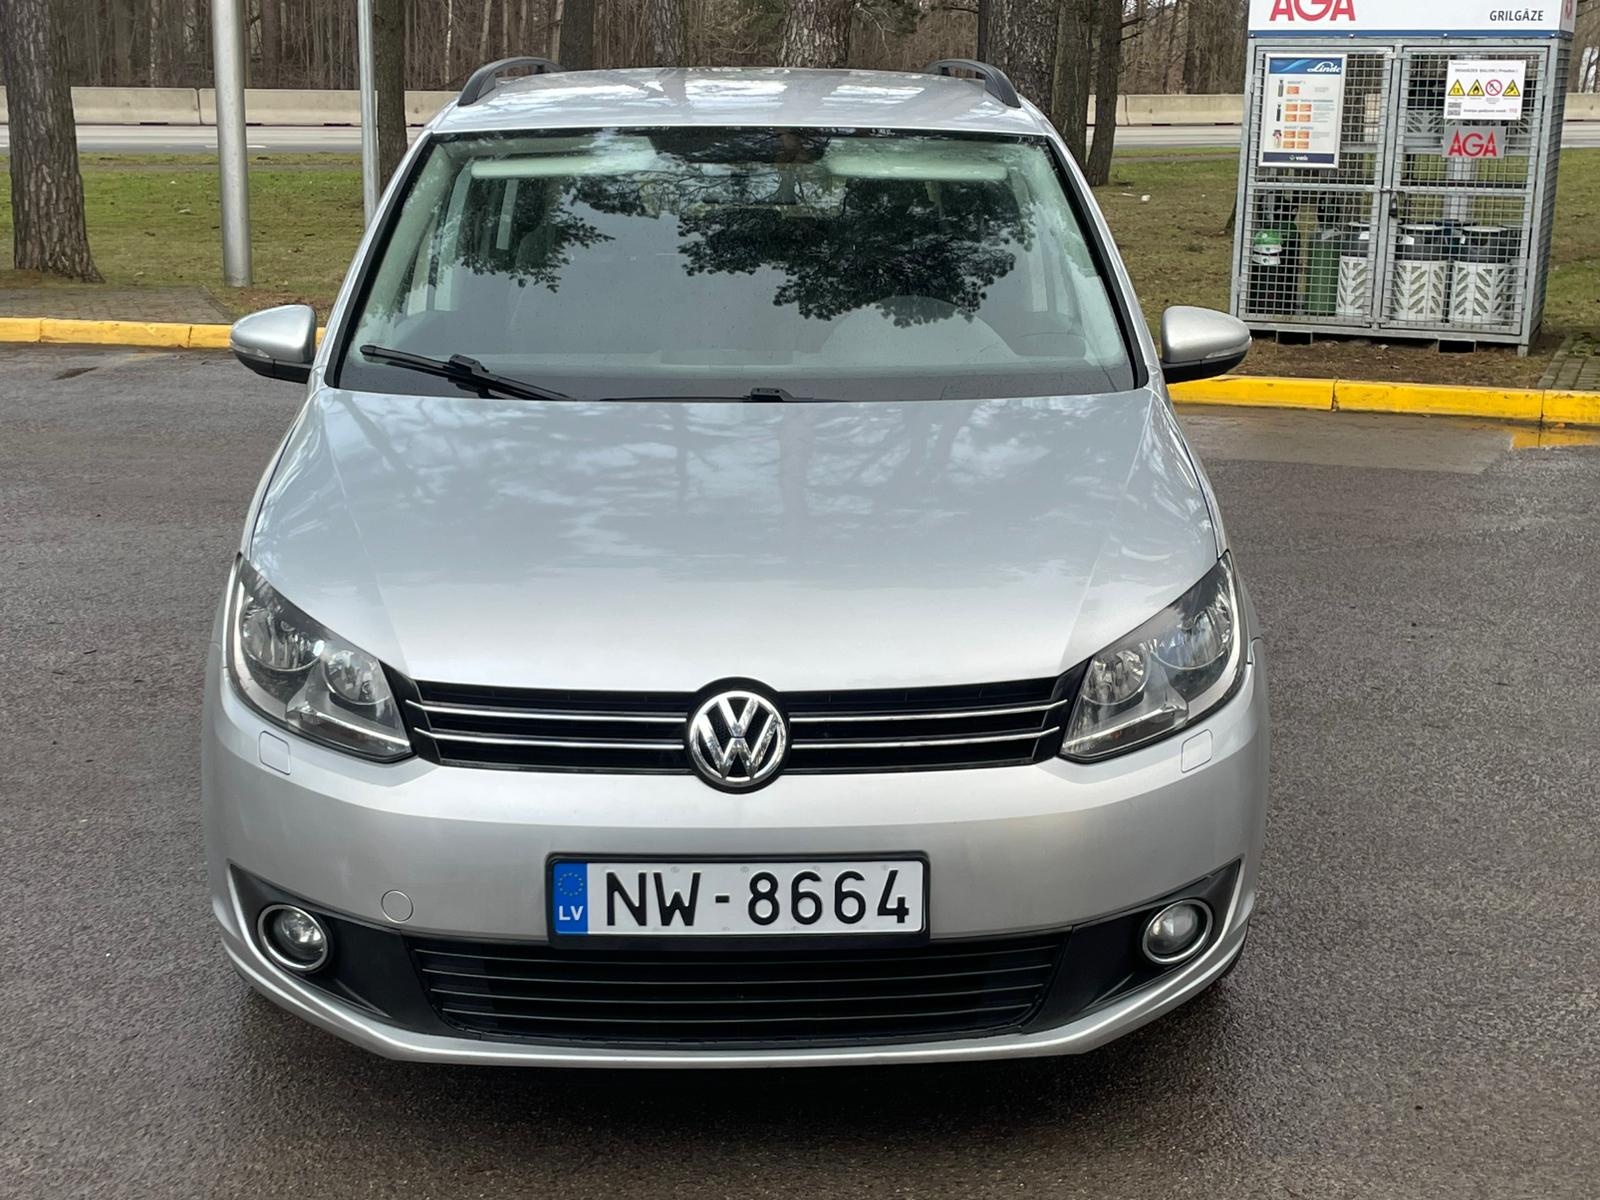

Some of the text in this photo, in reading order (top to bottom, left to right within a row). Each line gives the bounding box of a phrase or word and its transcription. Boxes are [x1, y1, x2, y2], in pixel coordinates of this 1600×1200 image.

[1306, 61, 1341, 73] Linde
[1448, 127, 1497, 157] AGA
[558, 905, 585, 921] LV
